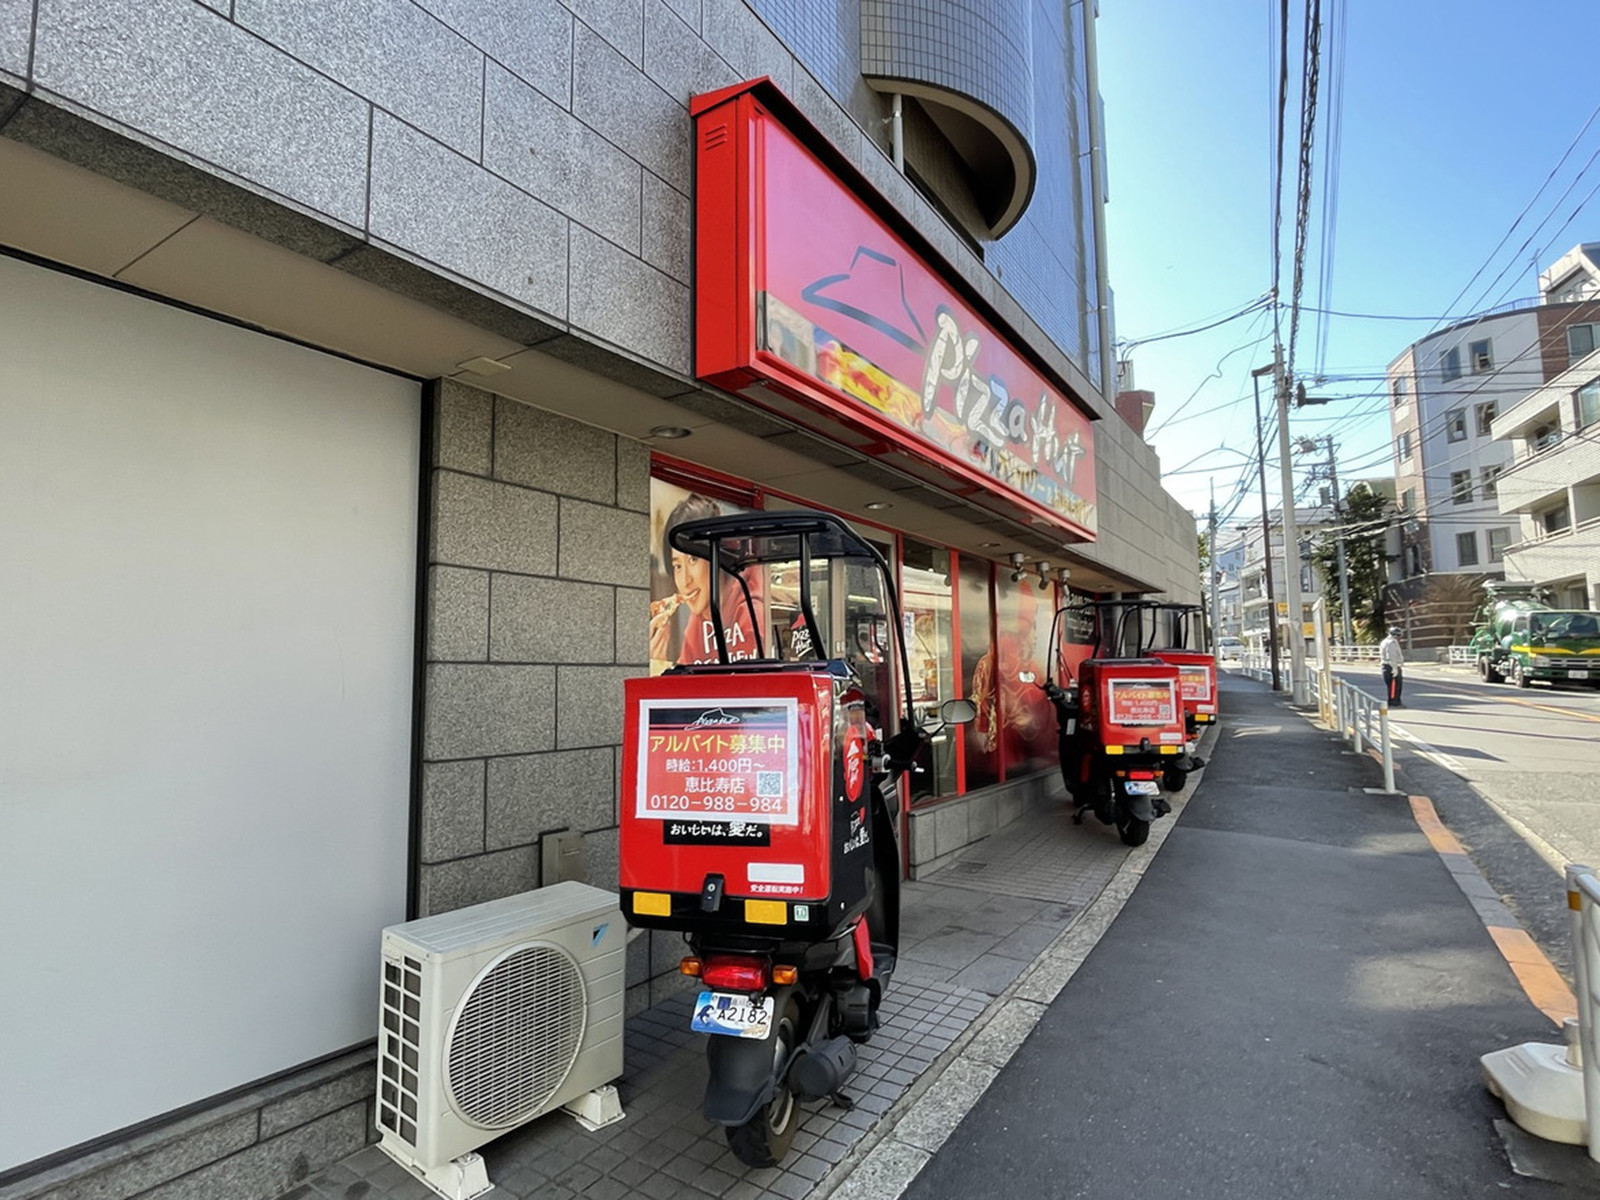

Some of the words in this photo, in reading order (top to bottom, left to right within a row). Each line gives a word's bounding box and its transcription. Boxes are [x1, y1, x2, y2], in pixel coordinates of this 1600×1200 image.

[924, 311, 1027, 448] Pizza
[1031, 393, 1085, 484] Hut
[650, 734, 786, 754] アルバイト募集中
[684, 776, 746, 794] 恵比寿店
